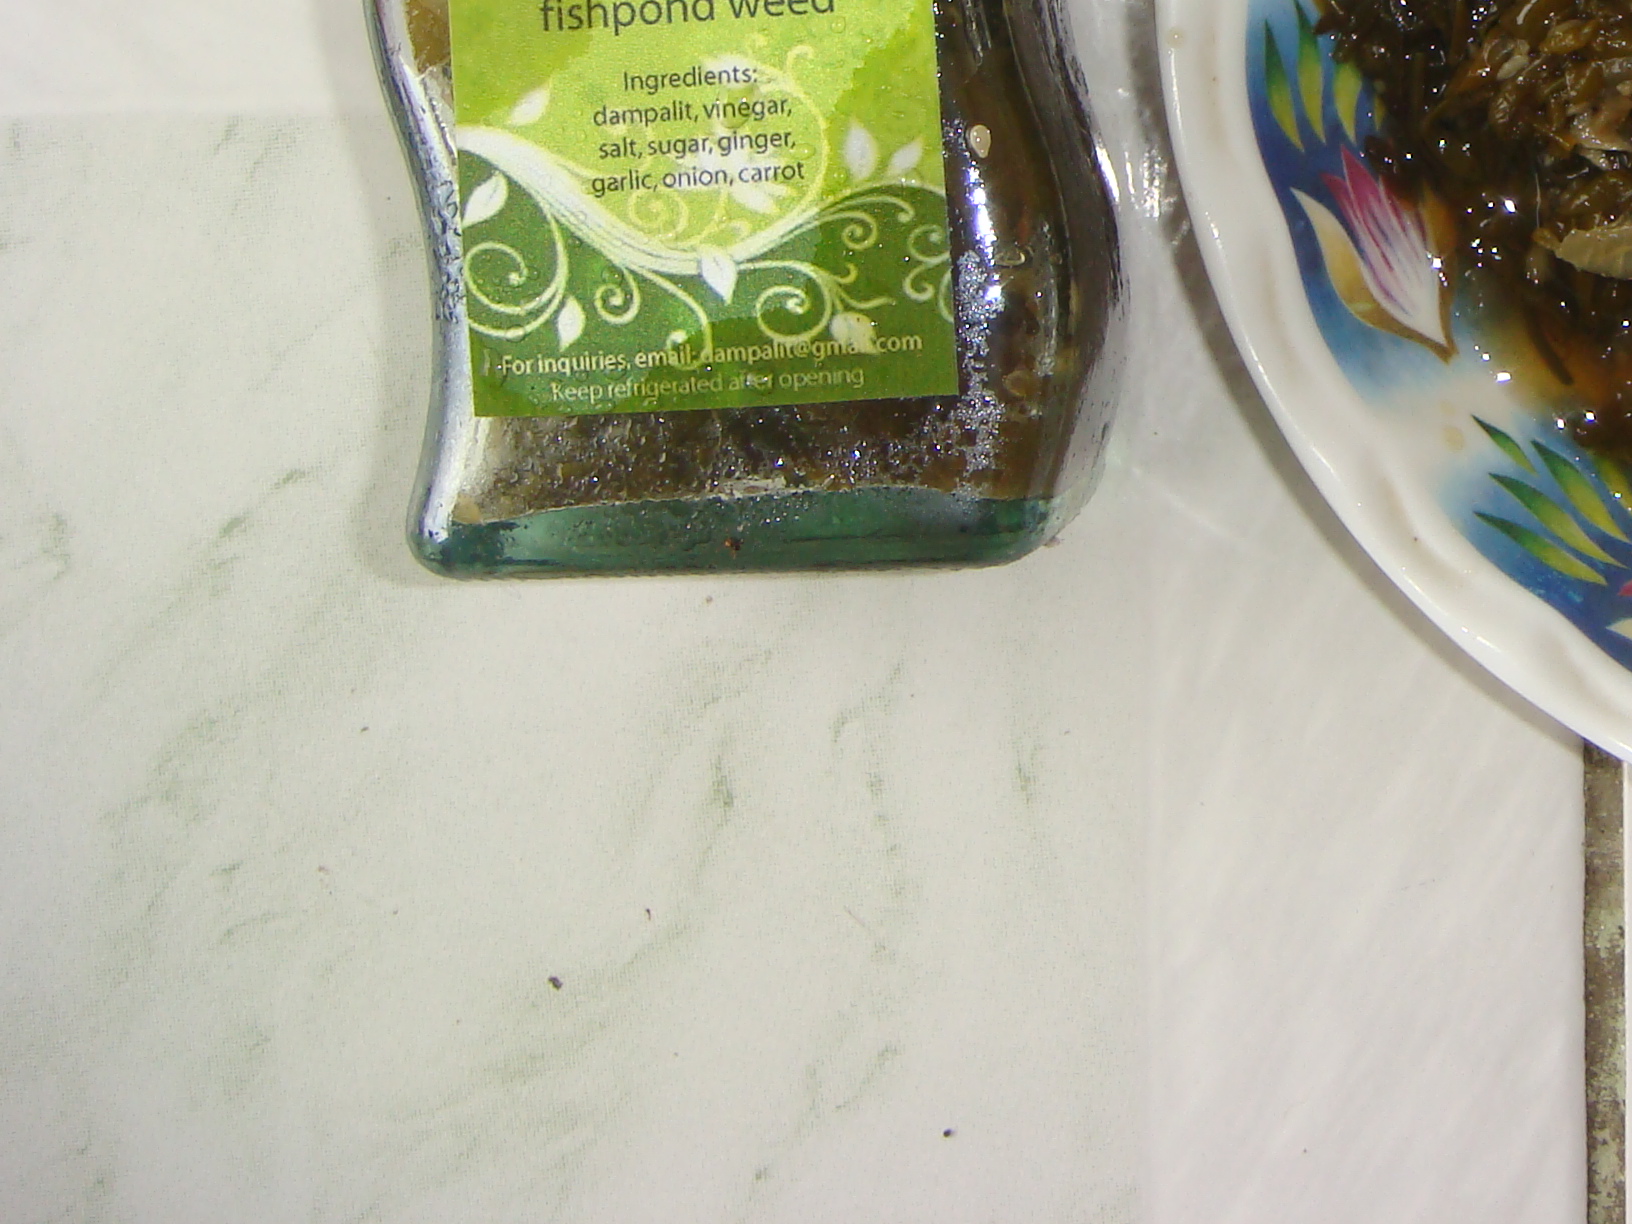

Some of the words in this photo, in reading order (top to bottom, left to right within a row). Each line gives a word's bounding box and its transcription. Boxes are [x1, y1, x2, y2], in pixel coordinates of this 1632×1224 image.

[624, 65, 758, 95] Ingredients:
[593, 100, 698, 127] dampalit,
[703, 96, 792, 121] vinegar,
[599, 137, 643, 160] salt,
[648, 136, 713, 158] sugar,
[718, 130, 796, 156] ginger,
[592, 168, 658, 198] garlic,
[662, 166, 734, 189] onion,
[738, 162, 804, 183] carrot
[502, 355, 532, 375] For
[700, 334, 923, 365] dampalit@gmacom
[551, 381, 603, 404] Keep
[607, 373, 723, 401] refrigerated
[778, 368, 865, 391] opening
